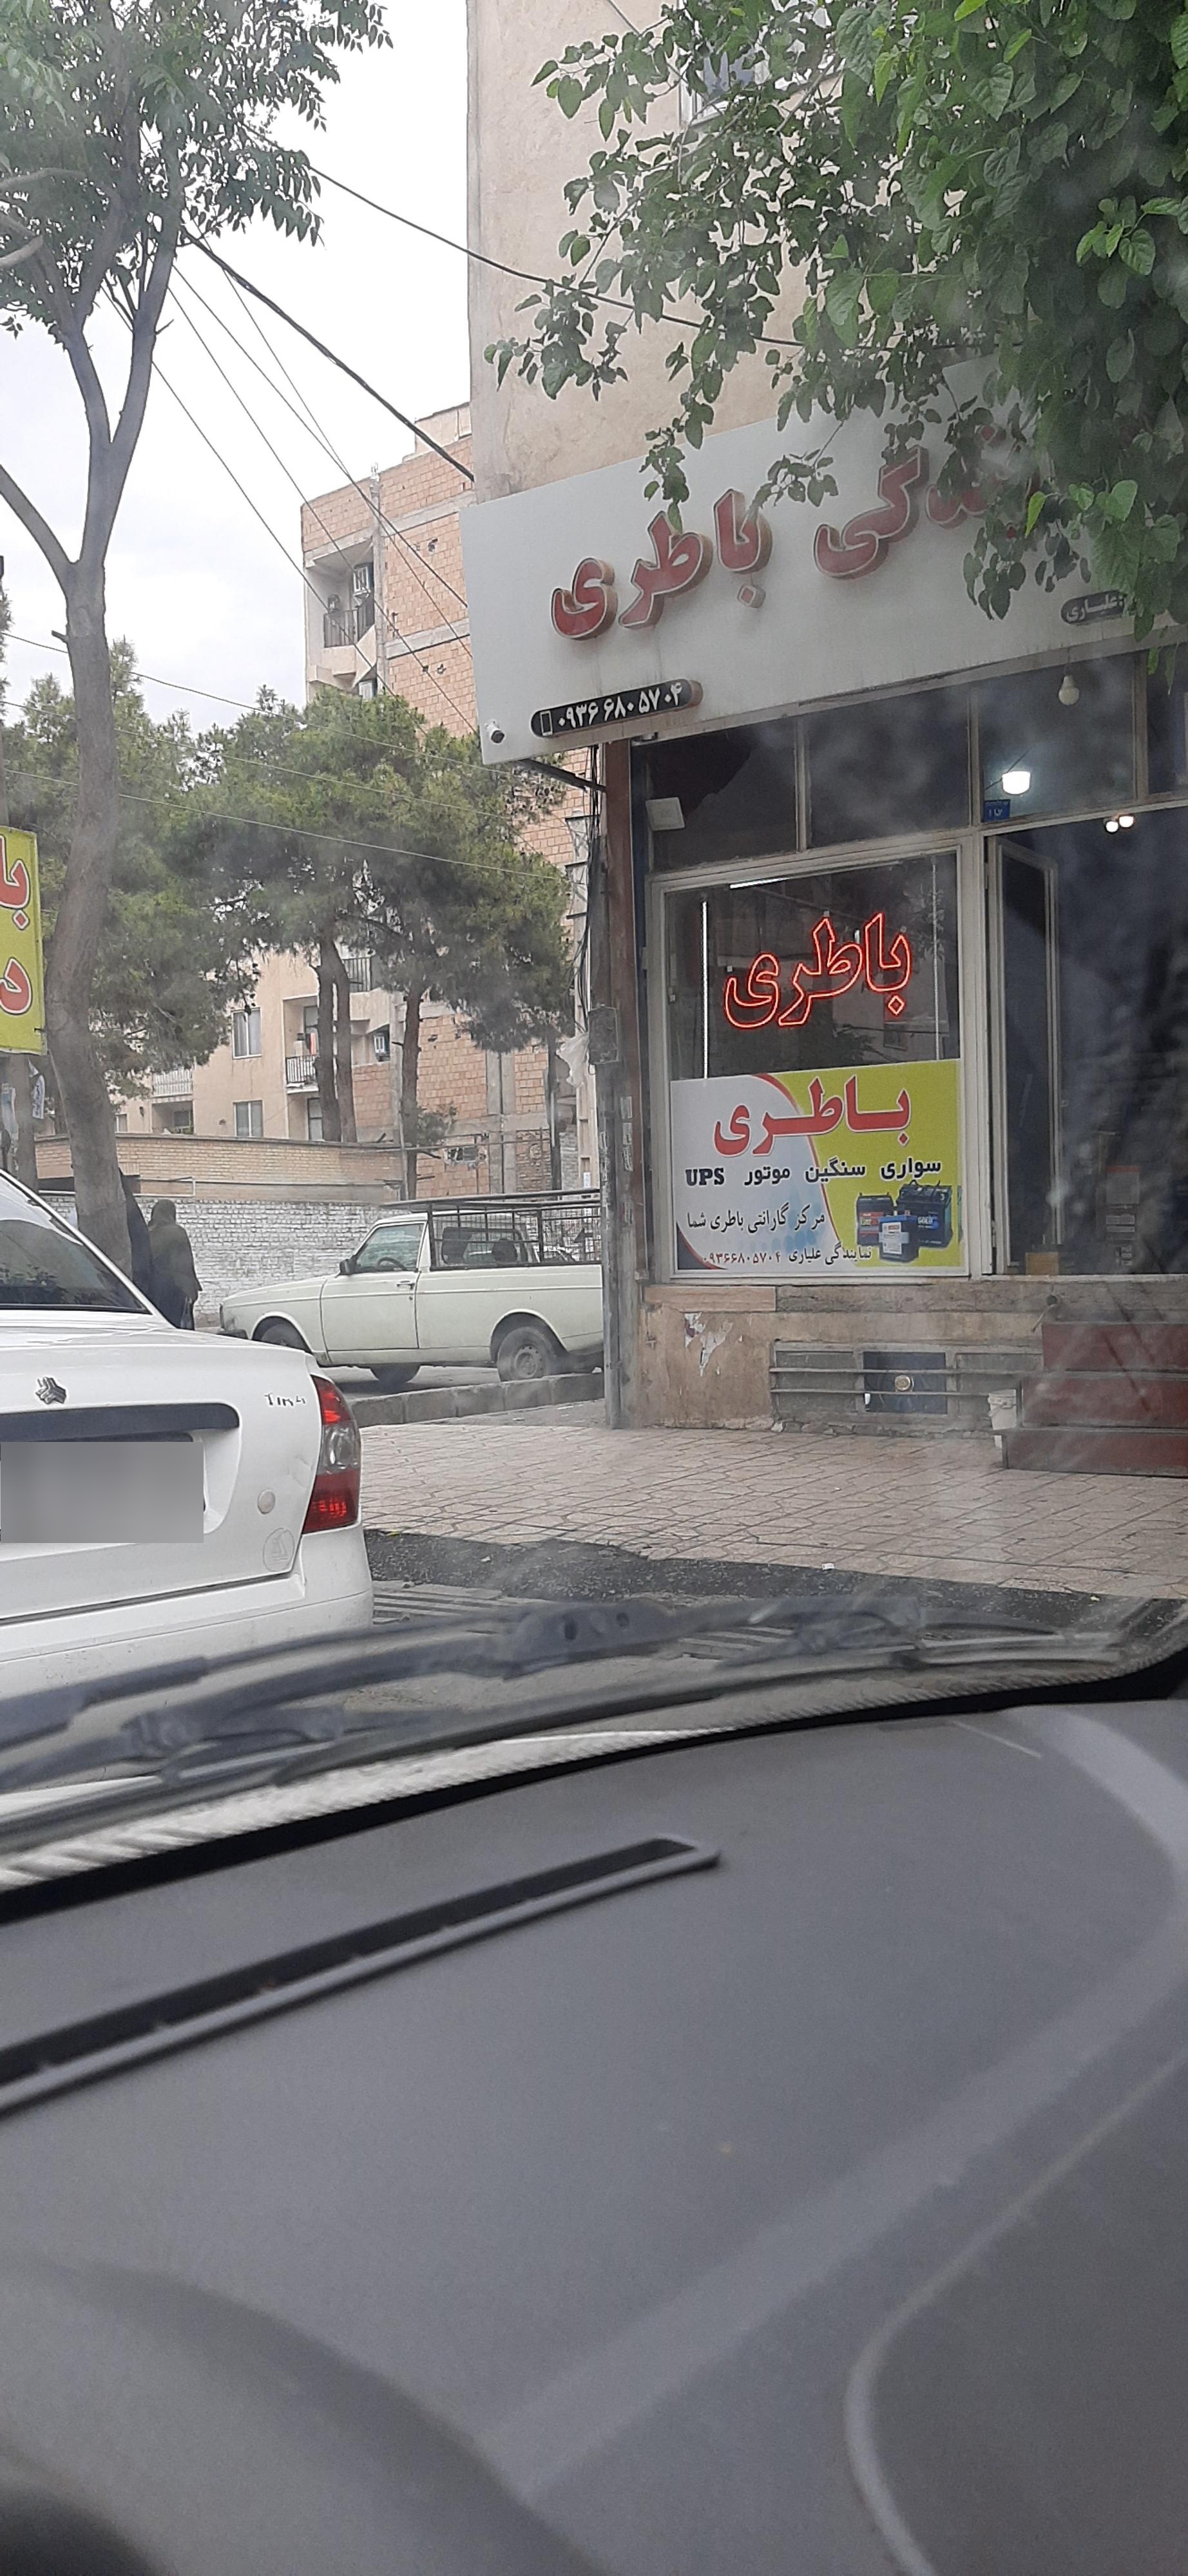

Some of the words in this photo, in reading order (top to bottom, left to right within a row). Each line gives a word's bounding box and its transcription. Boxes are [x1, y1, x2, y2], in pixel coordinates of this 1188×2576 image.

[551, 488, 769, 640] باطری
[724, 913, 912, 1029] باطری
[714, 1075, 911, 1157] باطری
[685, 1168, 725, 1186] UPS
[745, 1166, 790, 1186] موتور
[805, 1157, 865, 1184] سنگین
[881, 1157, 941, 1179] سواری
[687, 1211, 706, 1229] شما
[710, 1208, 743, 1233] باطری
[747, 1202, 789, 1234] گارانتی
[789, 1246, 821, 1264] علیاری
[825, 1242, 872, 1265] نمایندگی
